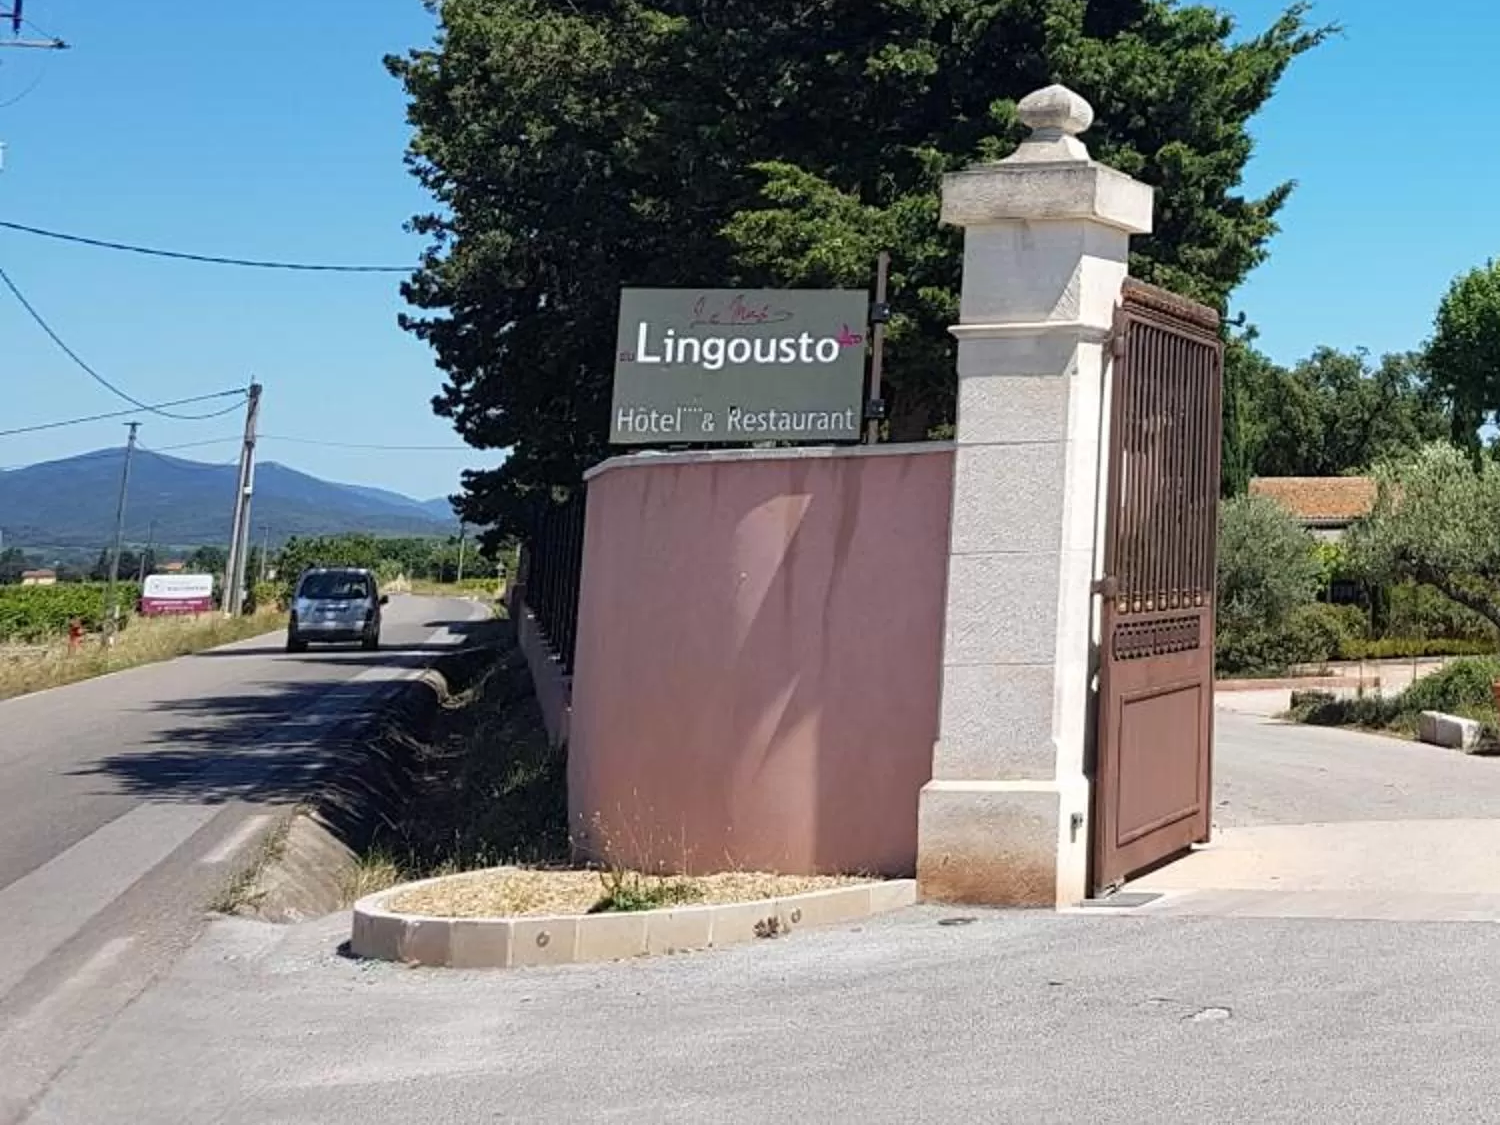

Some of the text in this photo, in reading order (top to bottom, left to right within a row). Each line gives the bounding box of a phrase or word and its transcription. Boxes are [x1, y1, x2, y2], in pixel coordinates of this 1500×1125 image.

[636, 321, 840, 370] Lingousto
[617, 406, 855, 433] Hôtel & Restaurant
